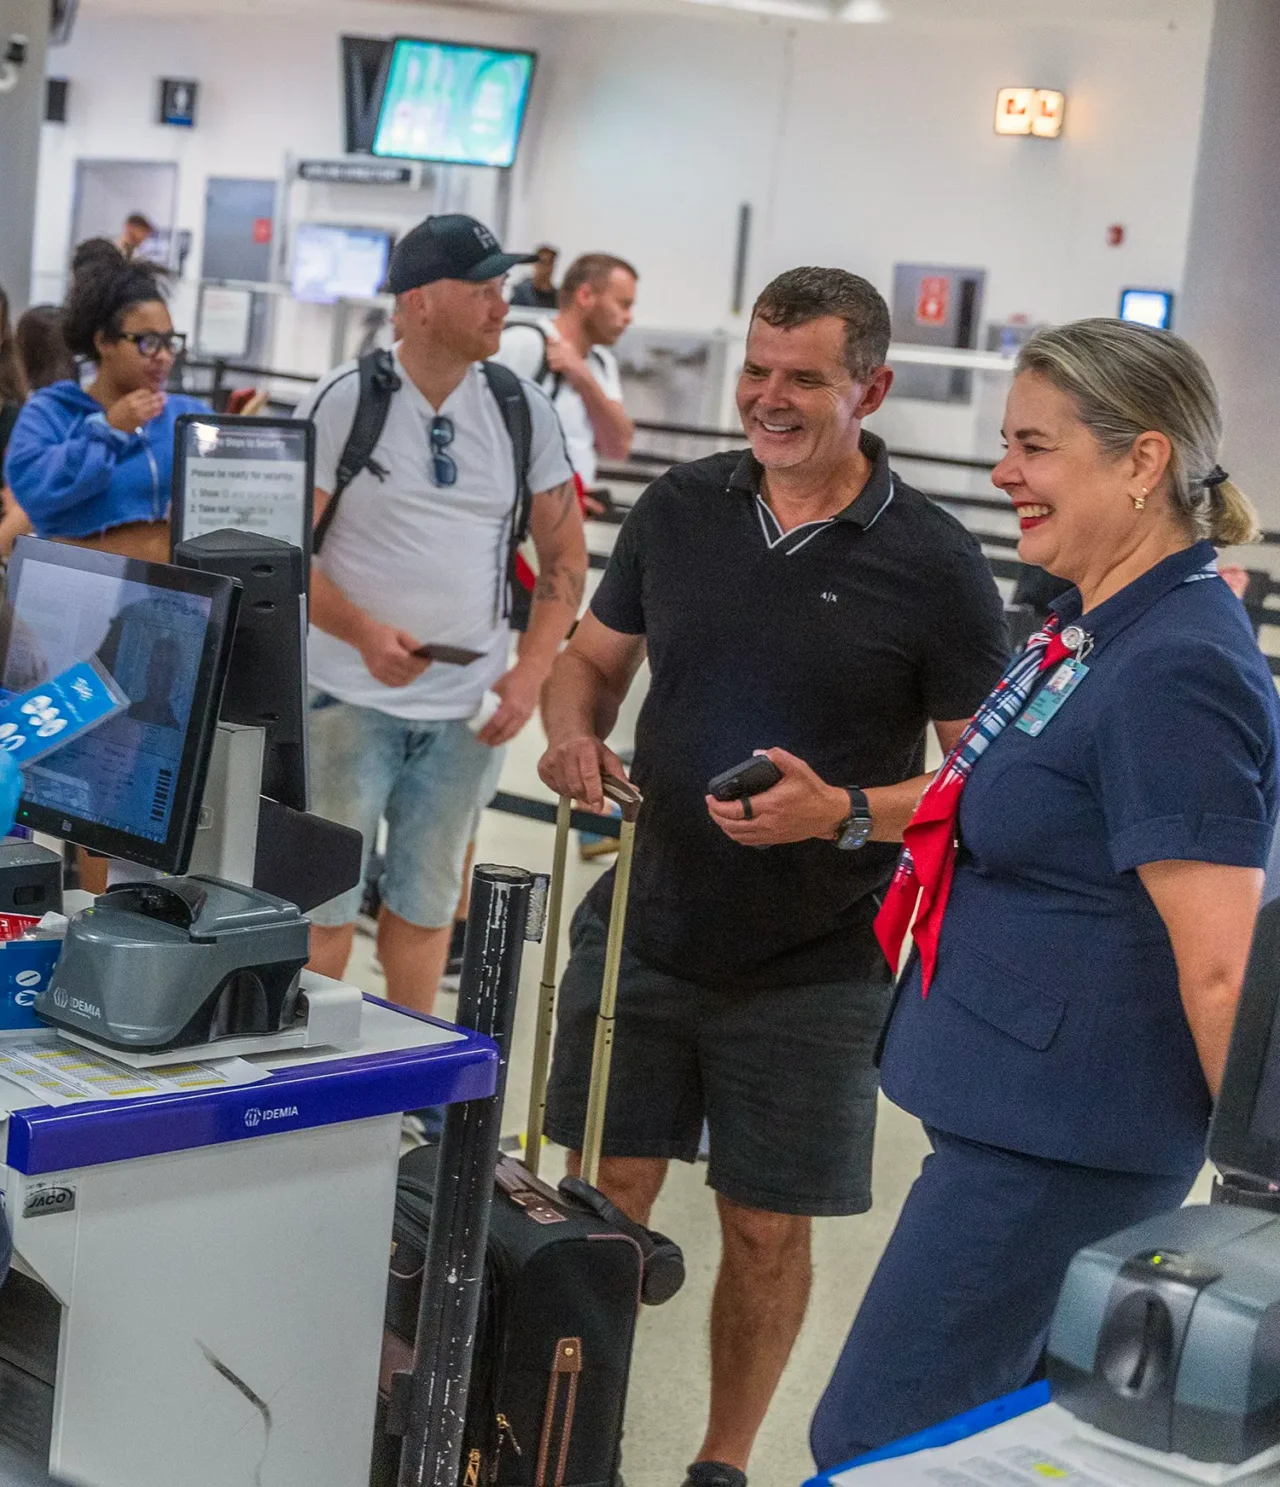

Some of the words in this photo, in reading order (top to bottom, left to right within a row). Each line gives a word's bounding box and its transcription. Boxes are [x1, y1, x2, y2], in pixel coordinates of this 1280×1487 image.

[70, 996, 101, 1019] IDEMIA
[263, 1105, 299, 1121] IDEMIA
[28, 1193, 66, 1208] JACO
